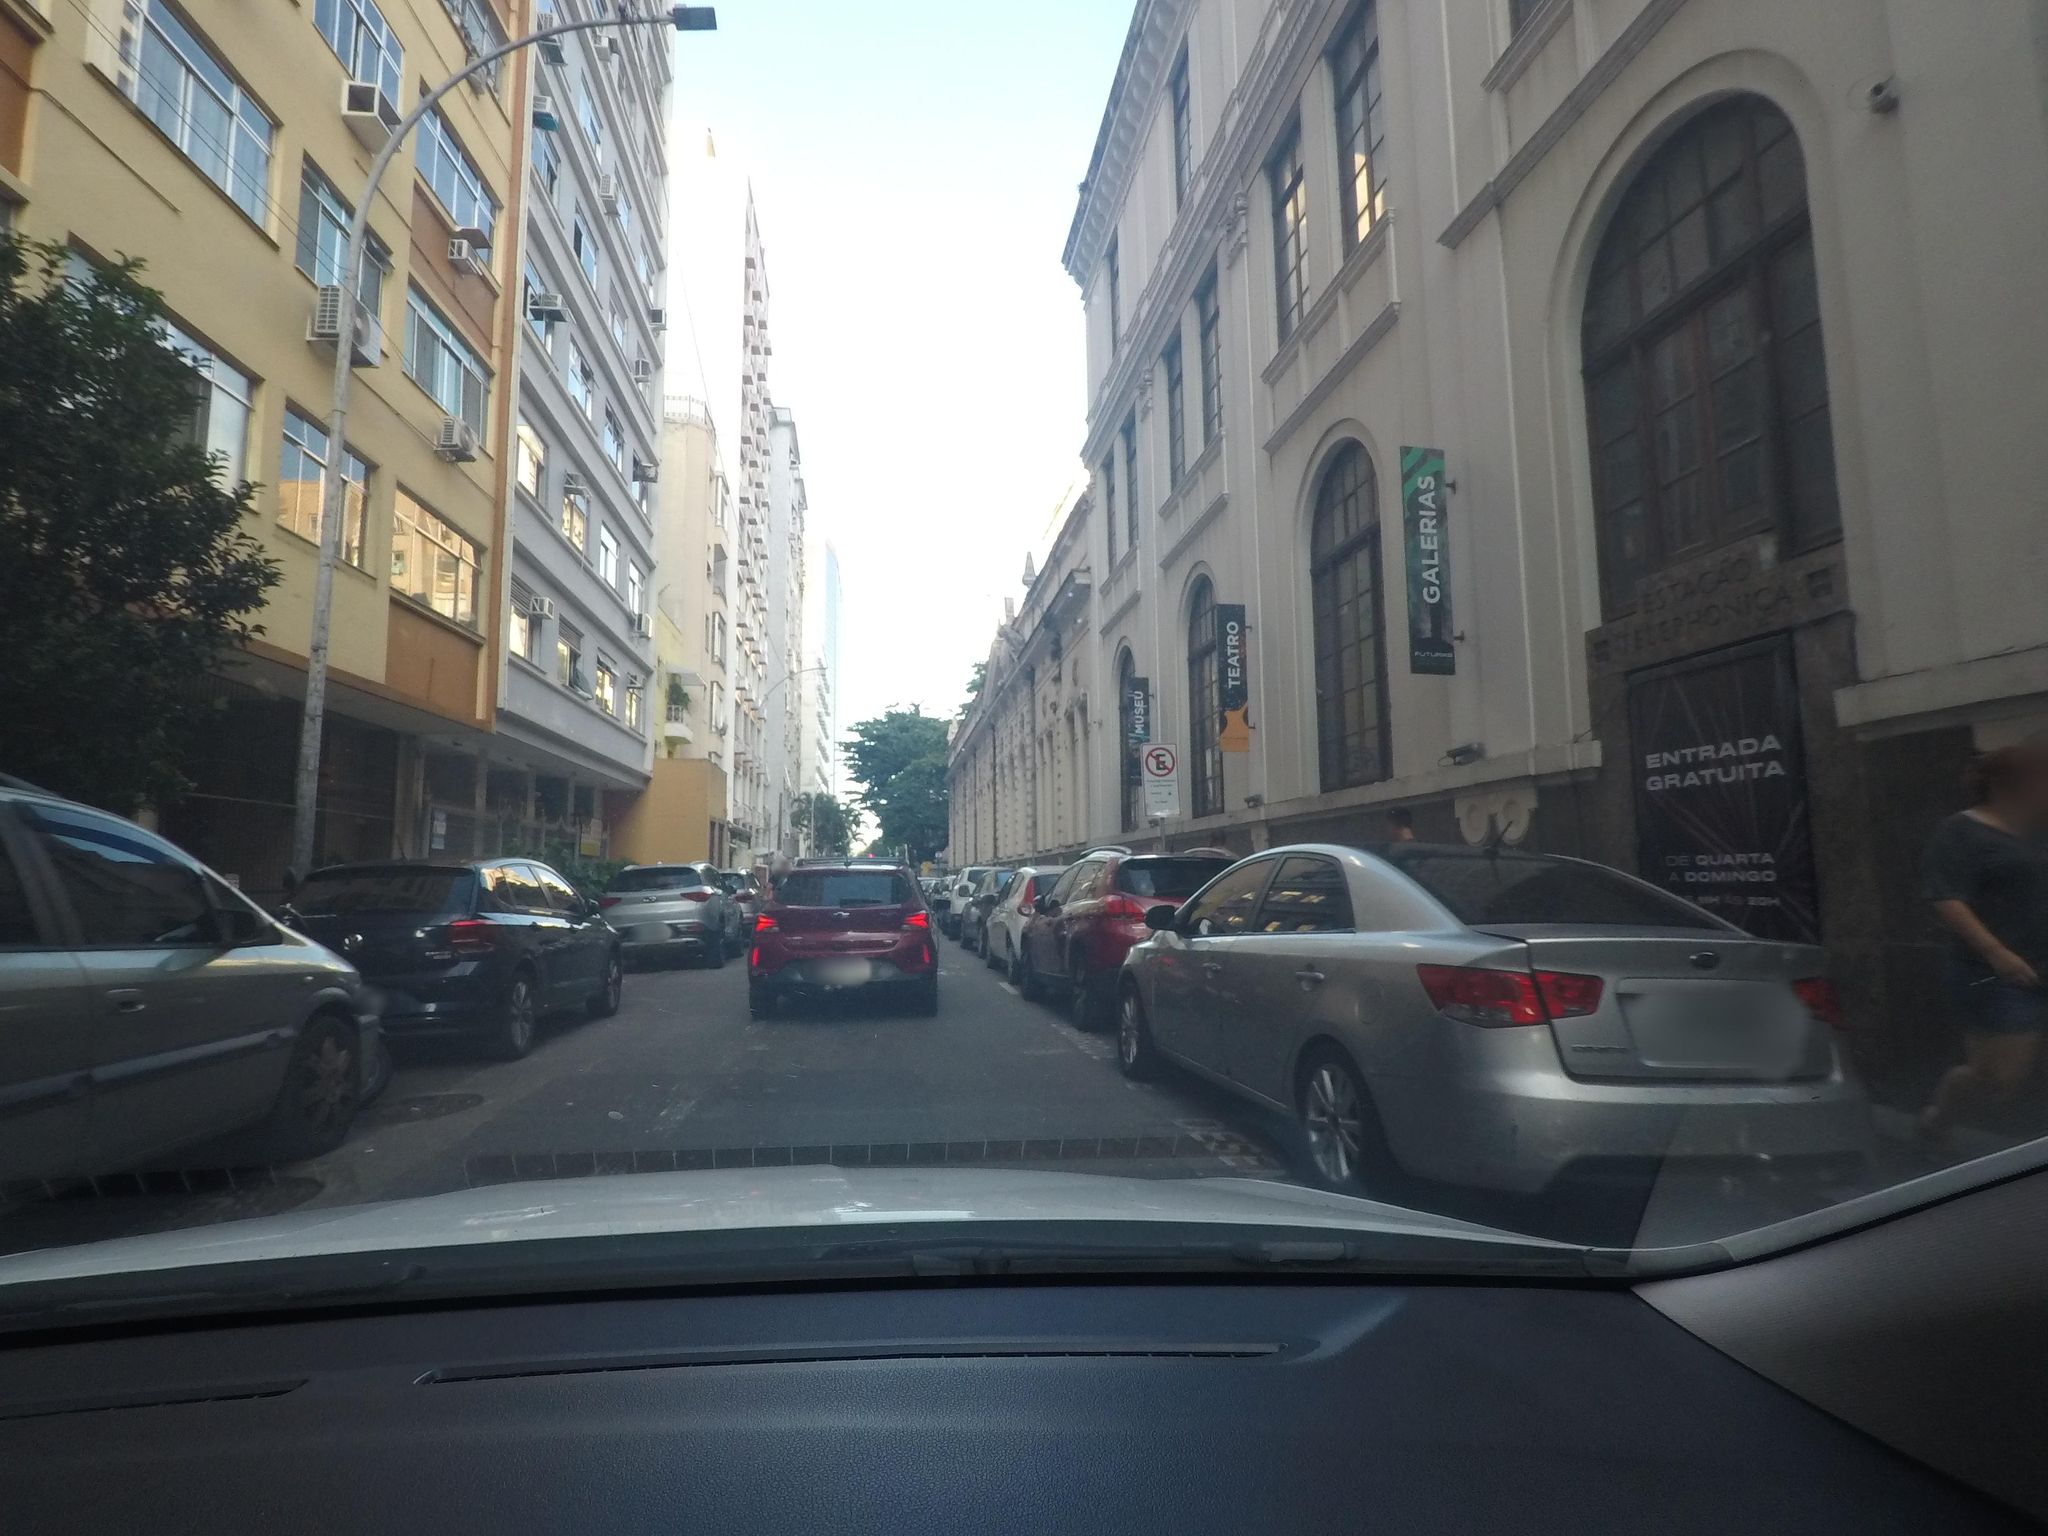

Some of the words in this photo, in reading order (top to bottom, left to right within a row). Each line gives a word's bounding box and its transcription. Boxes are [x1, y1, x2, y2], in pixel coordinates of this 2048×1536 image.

[1417, 475, 1441, 604] GALERIAS
[1226, 621, 1241, 689] TEATRO
[1134, 690, 1145, 734] MUSEU
[1155, 753, 1167, 771] E
[1646, 734, 1782, 769] ENTRADA
[1646, 760, 1786, 791] GRATUITA
[1664, 855, 1689, 866] DE
[1694, 852, 1775, 866] QUARTA
[1668, 871, 1680, 881] A
[1684, 870, 1777, 882] DOMINGO
